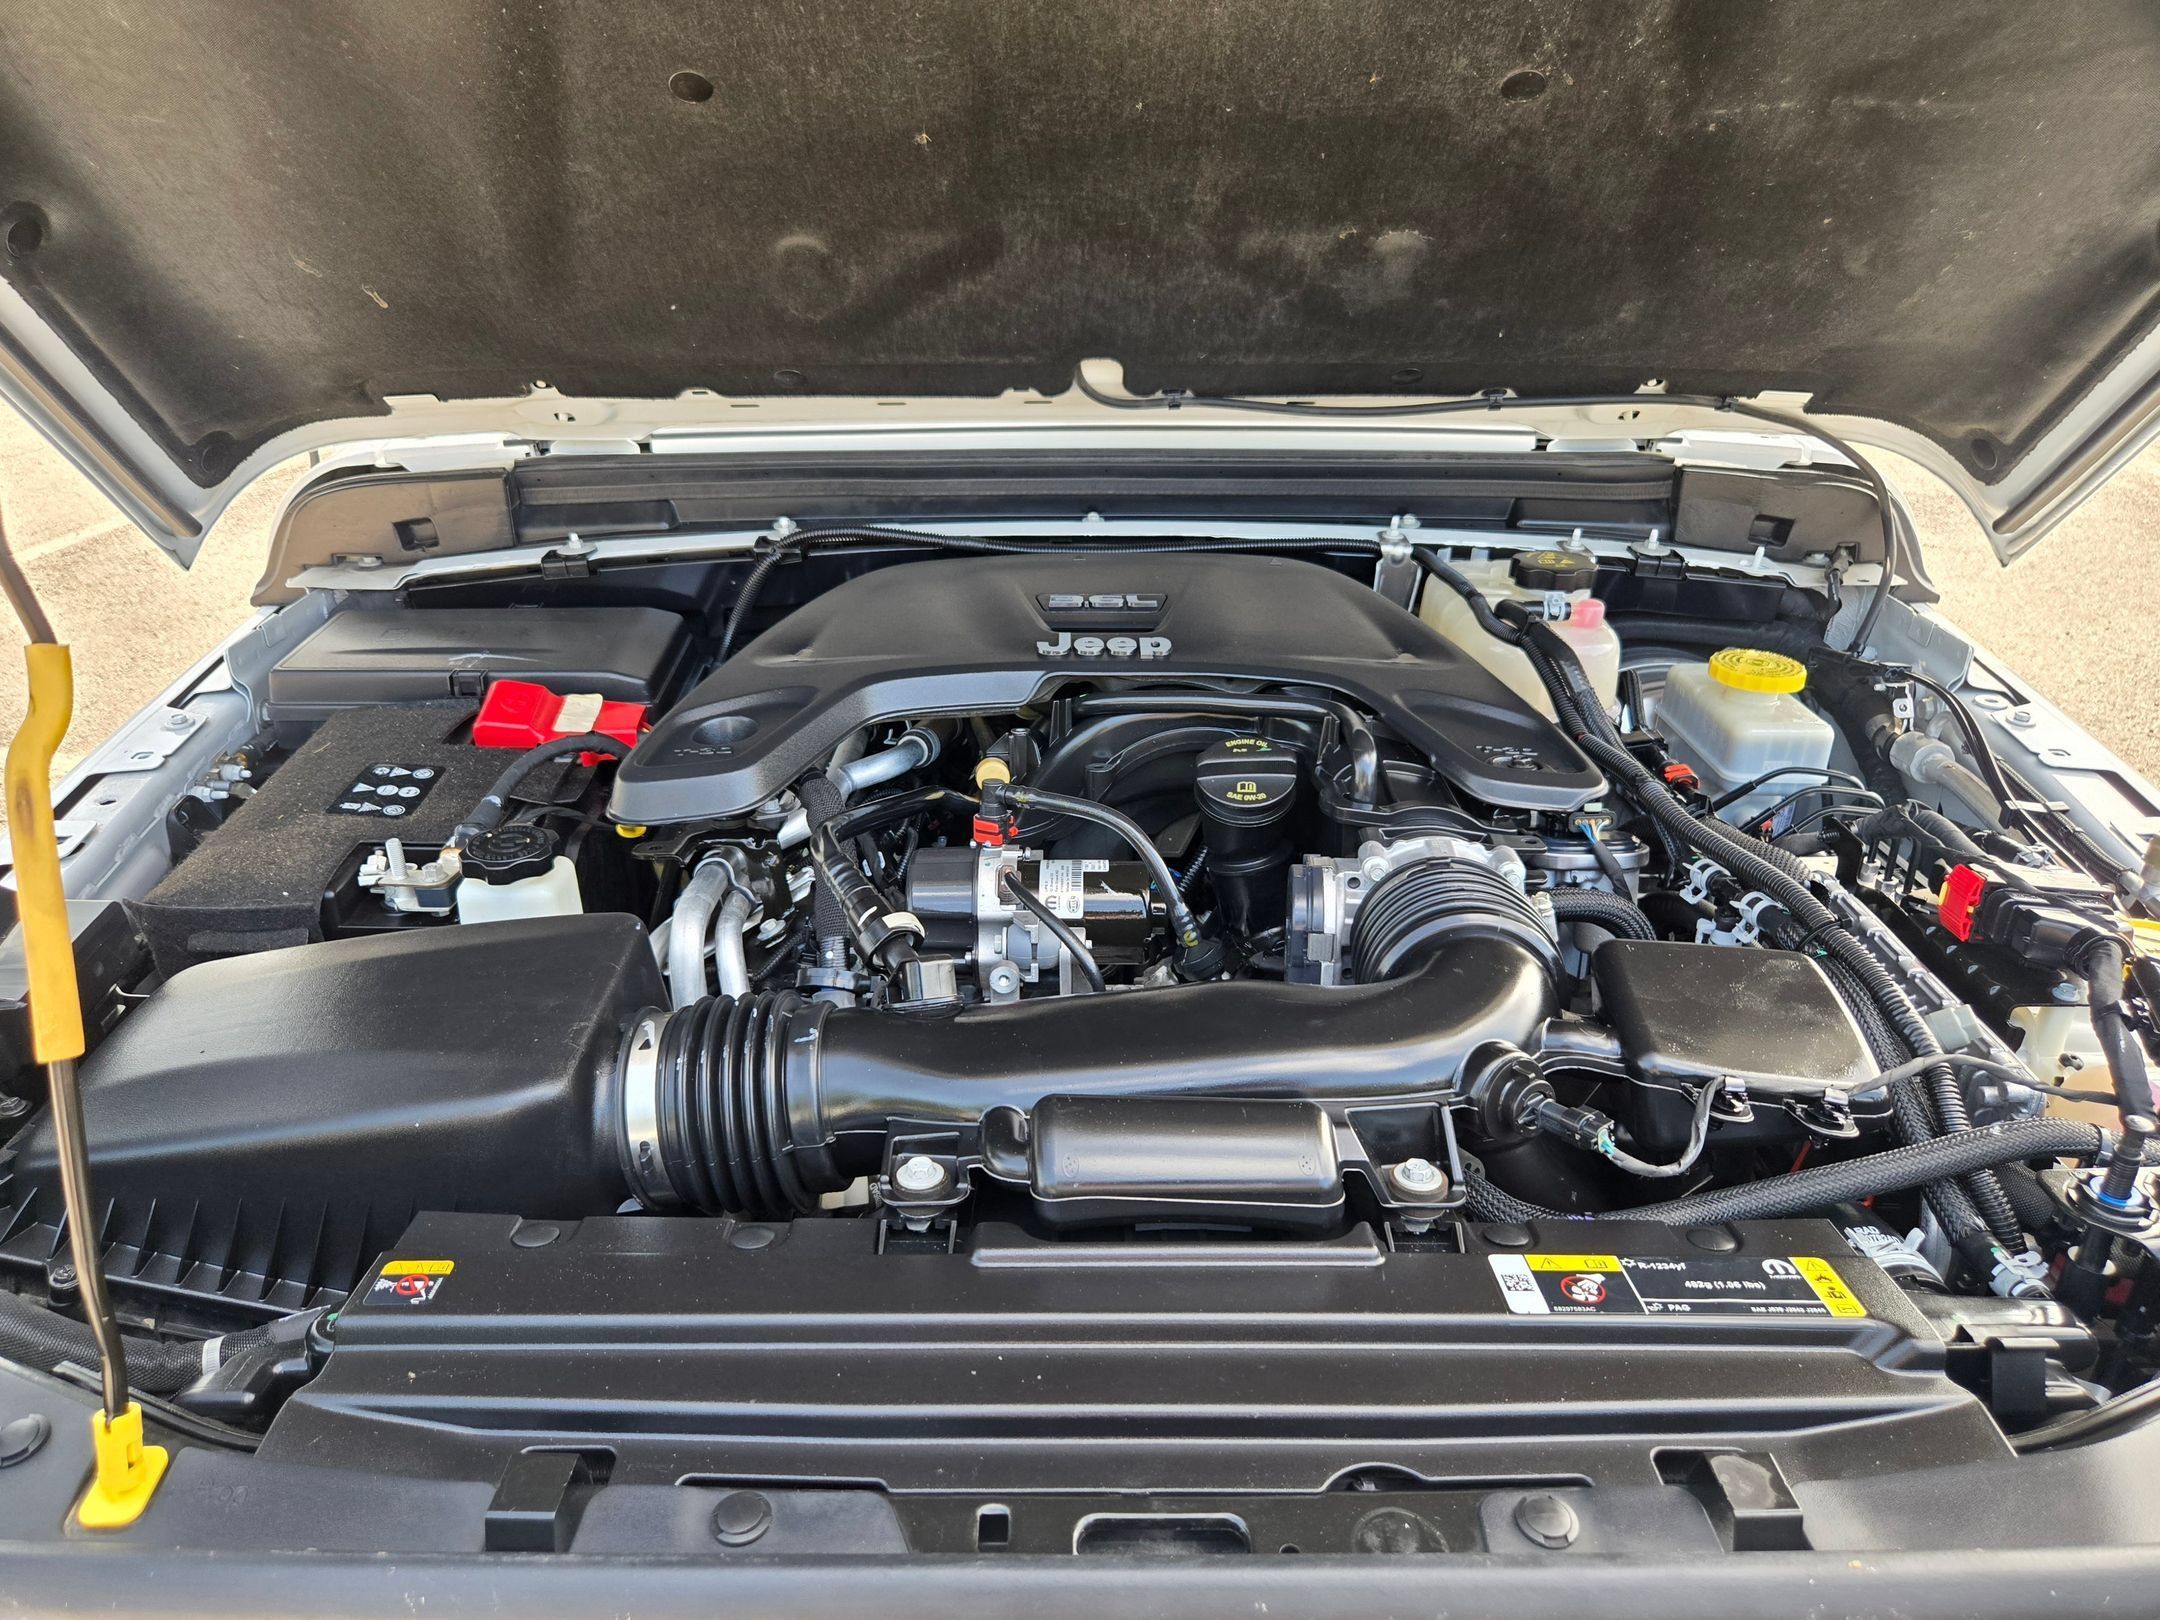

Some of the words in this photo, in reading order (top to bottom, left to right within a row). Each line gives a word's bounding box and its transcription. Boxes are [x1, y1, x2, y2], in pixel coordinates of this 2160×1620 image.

[1036, 631, 1172, 660] Jeep
[1225, 738, 1256, 748] ENGINE
[1256, 740, 1269, 748] OIL
[1226, 791, 1243, 800] SAE
[1244, 792, 1267, 801] 0W-20
[1668, 1304, 1692, 1312] PAG
